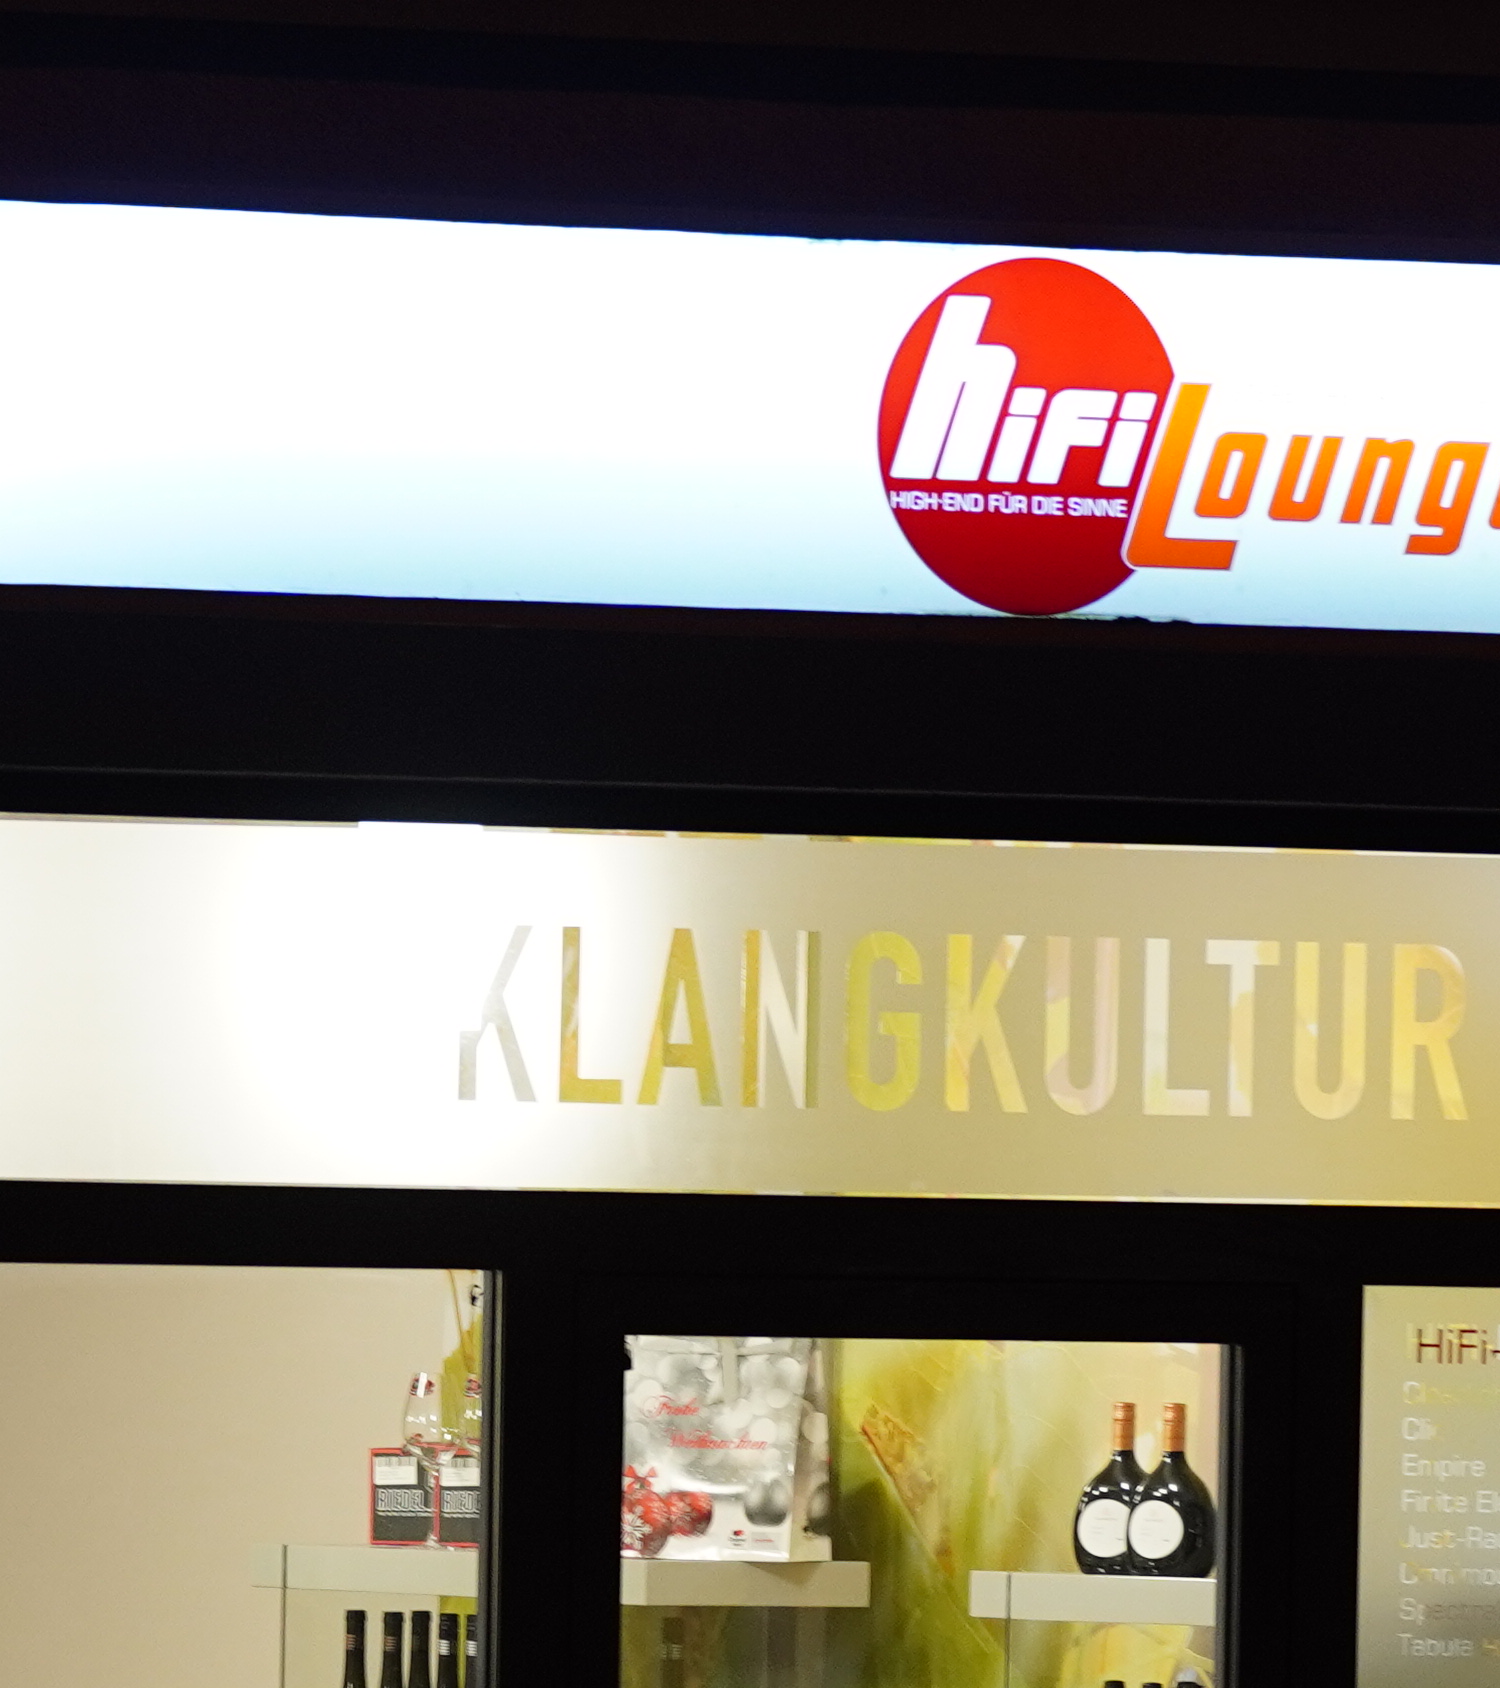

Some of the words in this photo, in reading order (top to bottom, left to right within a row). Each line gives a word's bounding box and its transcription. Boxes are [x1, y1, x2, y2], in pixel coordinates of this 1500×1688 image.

[889, 489, 985, 513] HIGH-END
[987, 490, 1029, 514] FÜR
[1030, 494, 1065, 516] DIE
[1066, 496, 1129, 518] SINNE
[456, 922, 1471, 1122] KLANGKULTUR
